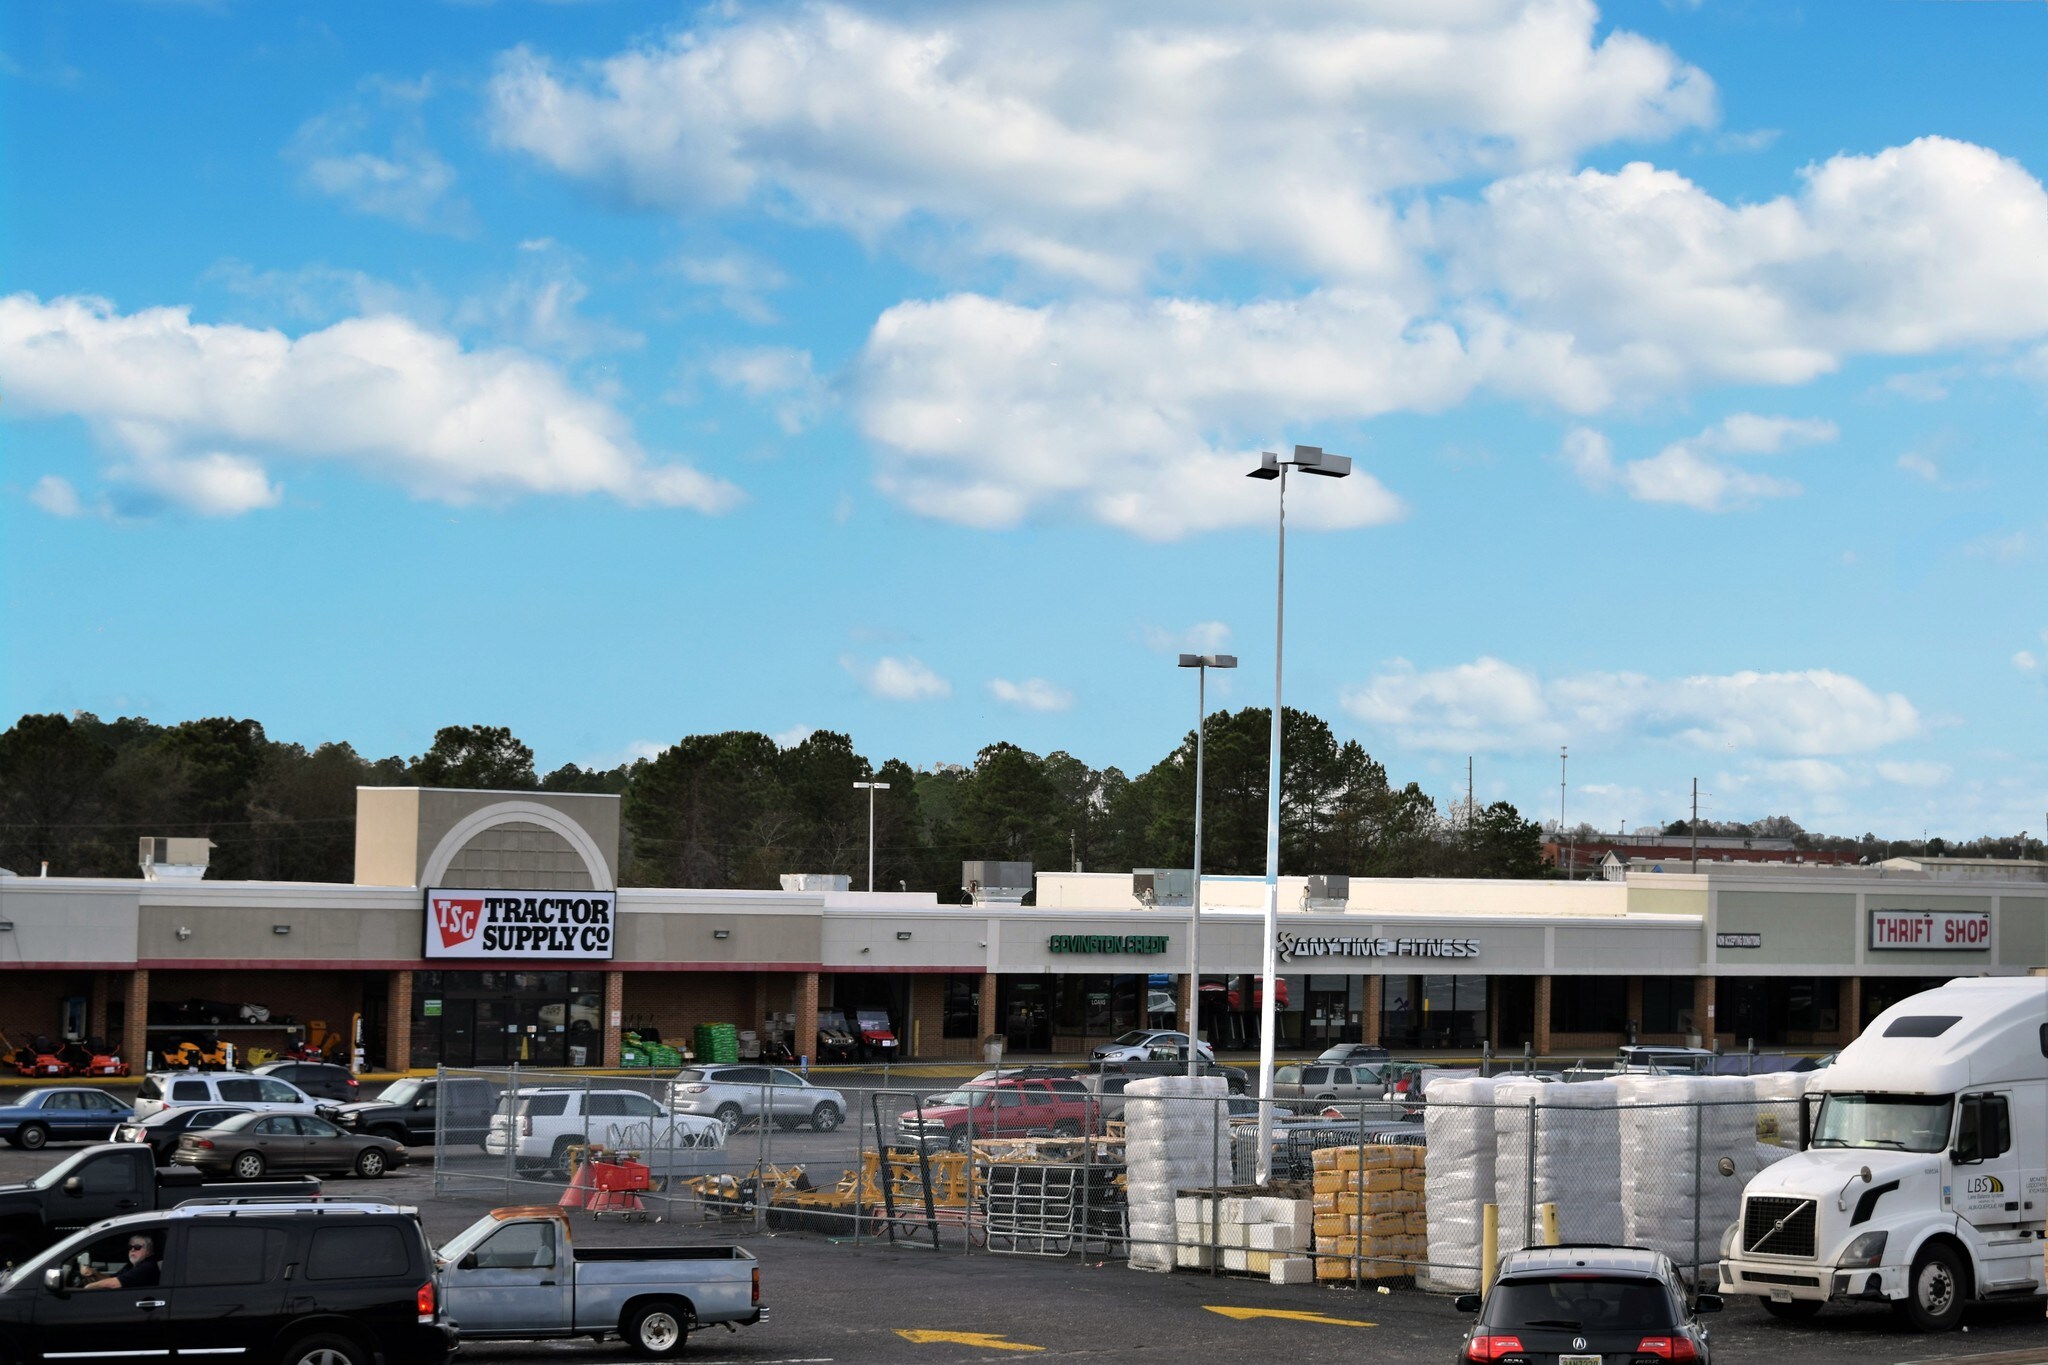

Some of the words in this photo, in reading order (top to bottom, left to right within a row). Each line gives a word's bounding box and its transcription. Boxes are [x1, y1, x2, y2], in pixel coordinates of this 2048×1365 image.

[438, 900, 475, 940] TSC
[484, 897, 610, 925] TRACTOR
[482, 925, 579, 951] SUPPLY
[1050, 934, 1123, 954] COVINGTON
[1125, 935, 1170, 954] CREDIT
[1876, 918, 1934, 943] THRIFT
[1944, 919, 1989, 944] SHOP
[1294, 936, 1389, 957] ANYTIME
[1396, 938, 1481, 958] FITNESS
[1967, 1177, 1988, 1193] LBS
